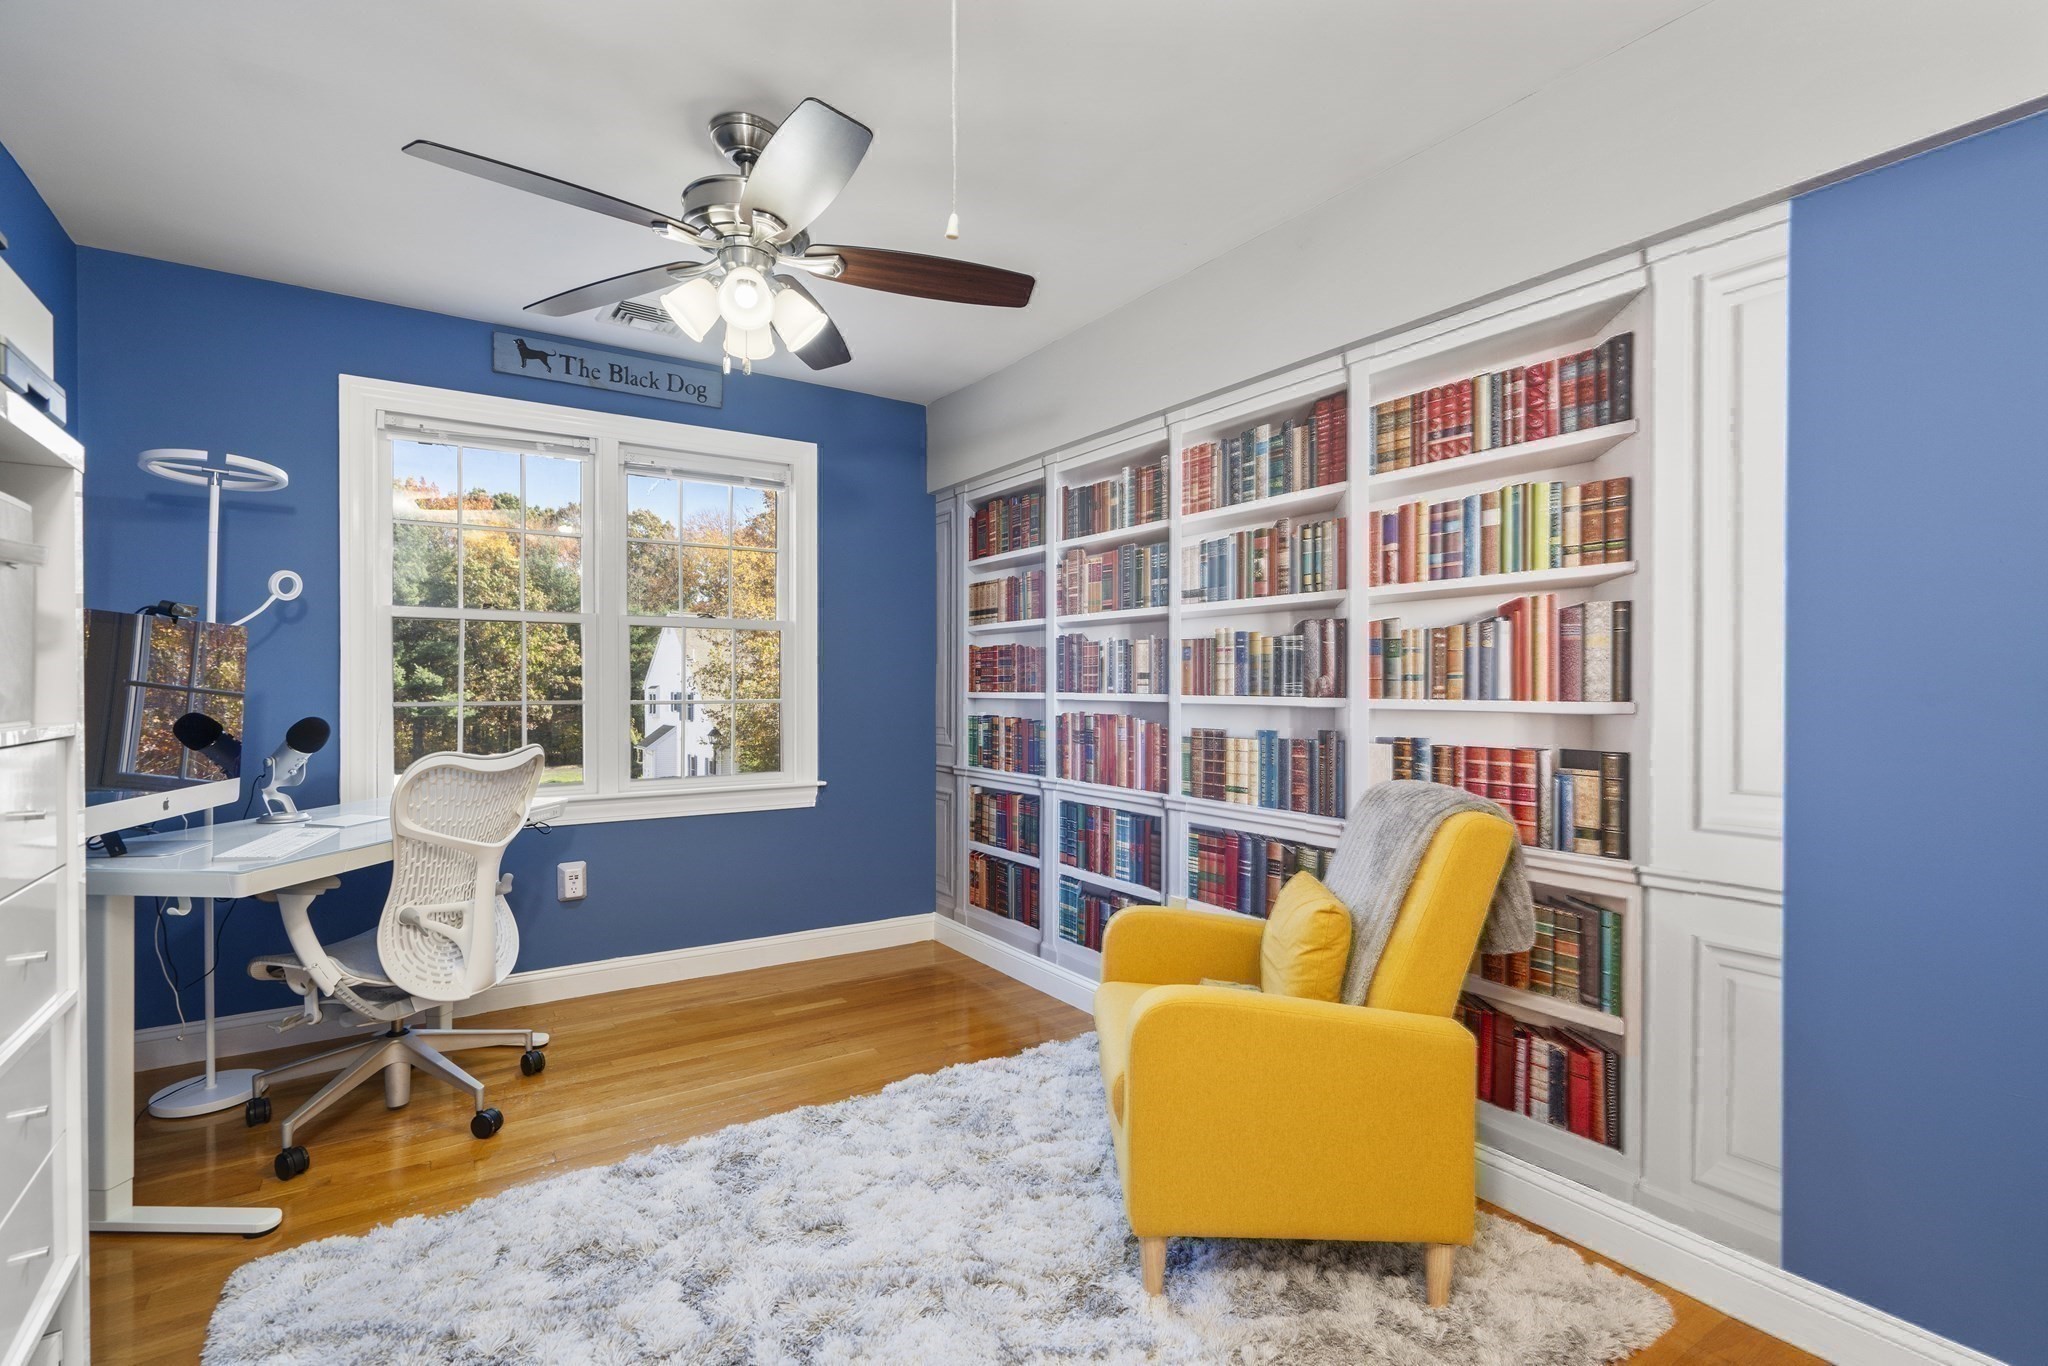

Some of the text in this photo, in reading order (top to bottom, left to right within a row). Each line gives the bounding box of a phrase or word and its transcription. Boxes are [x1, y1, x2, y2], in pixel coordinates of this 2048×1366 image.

[559, 354, 708, 403] The Black Dog
